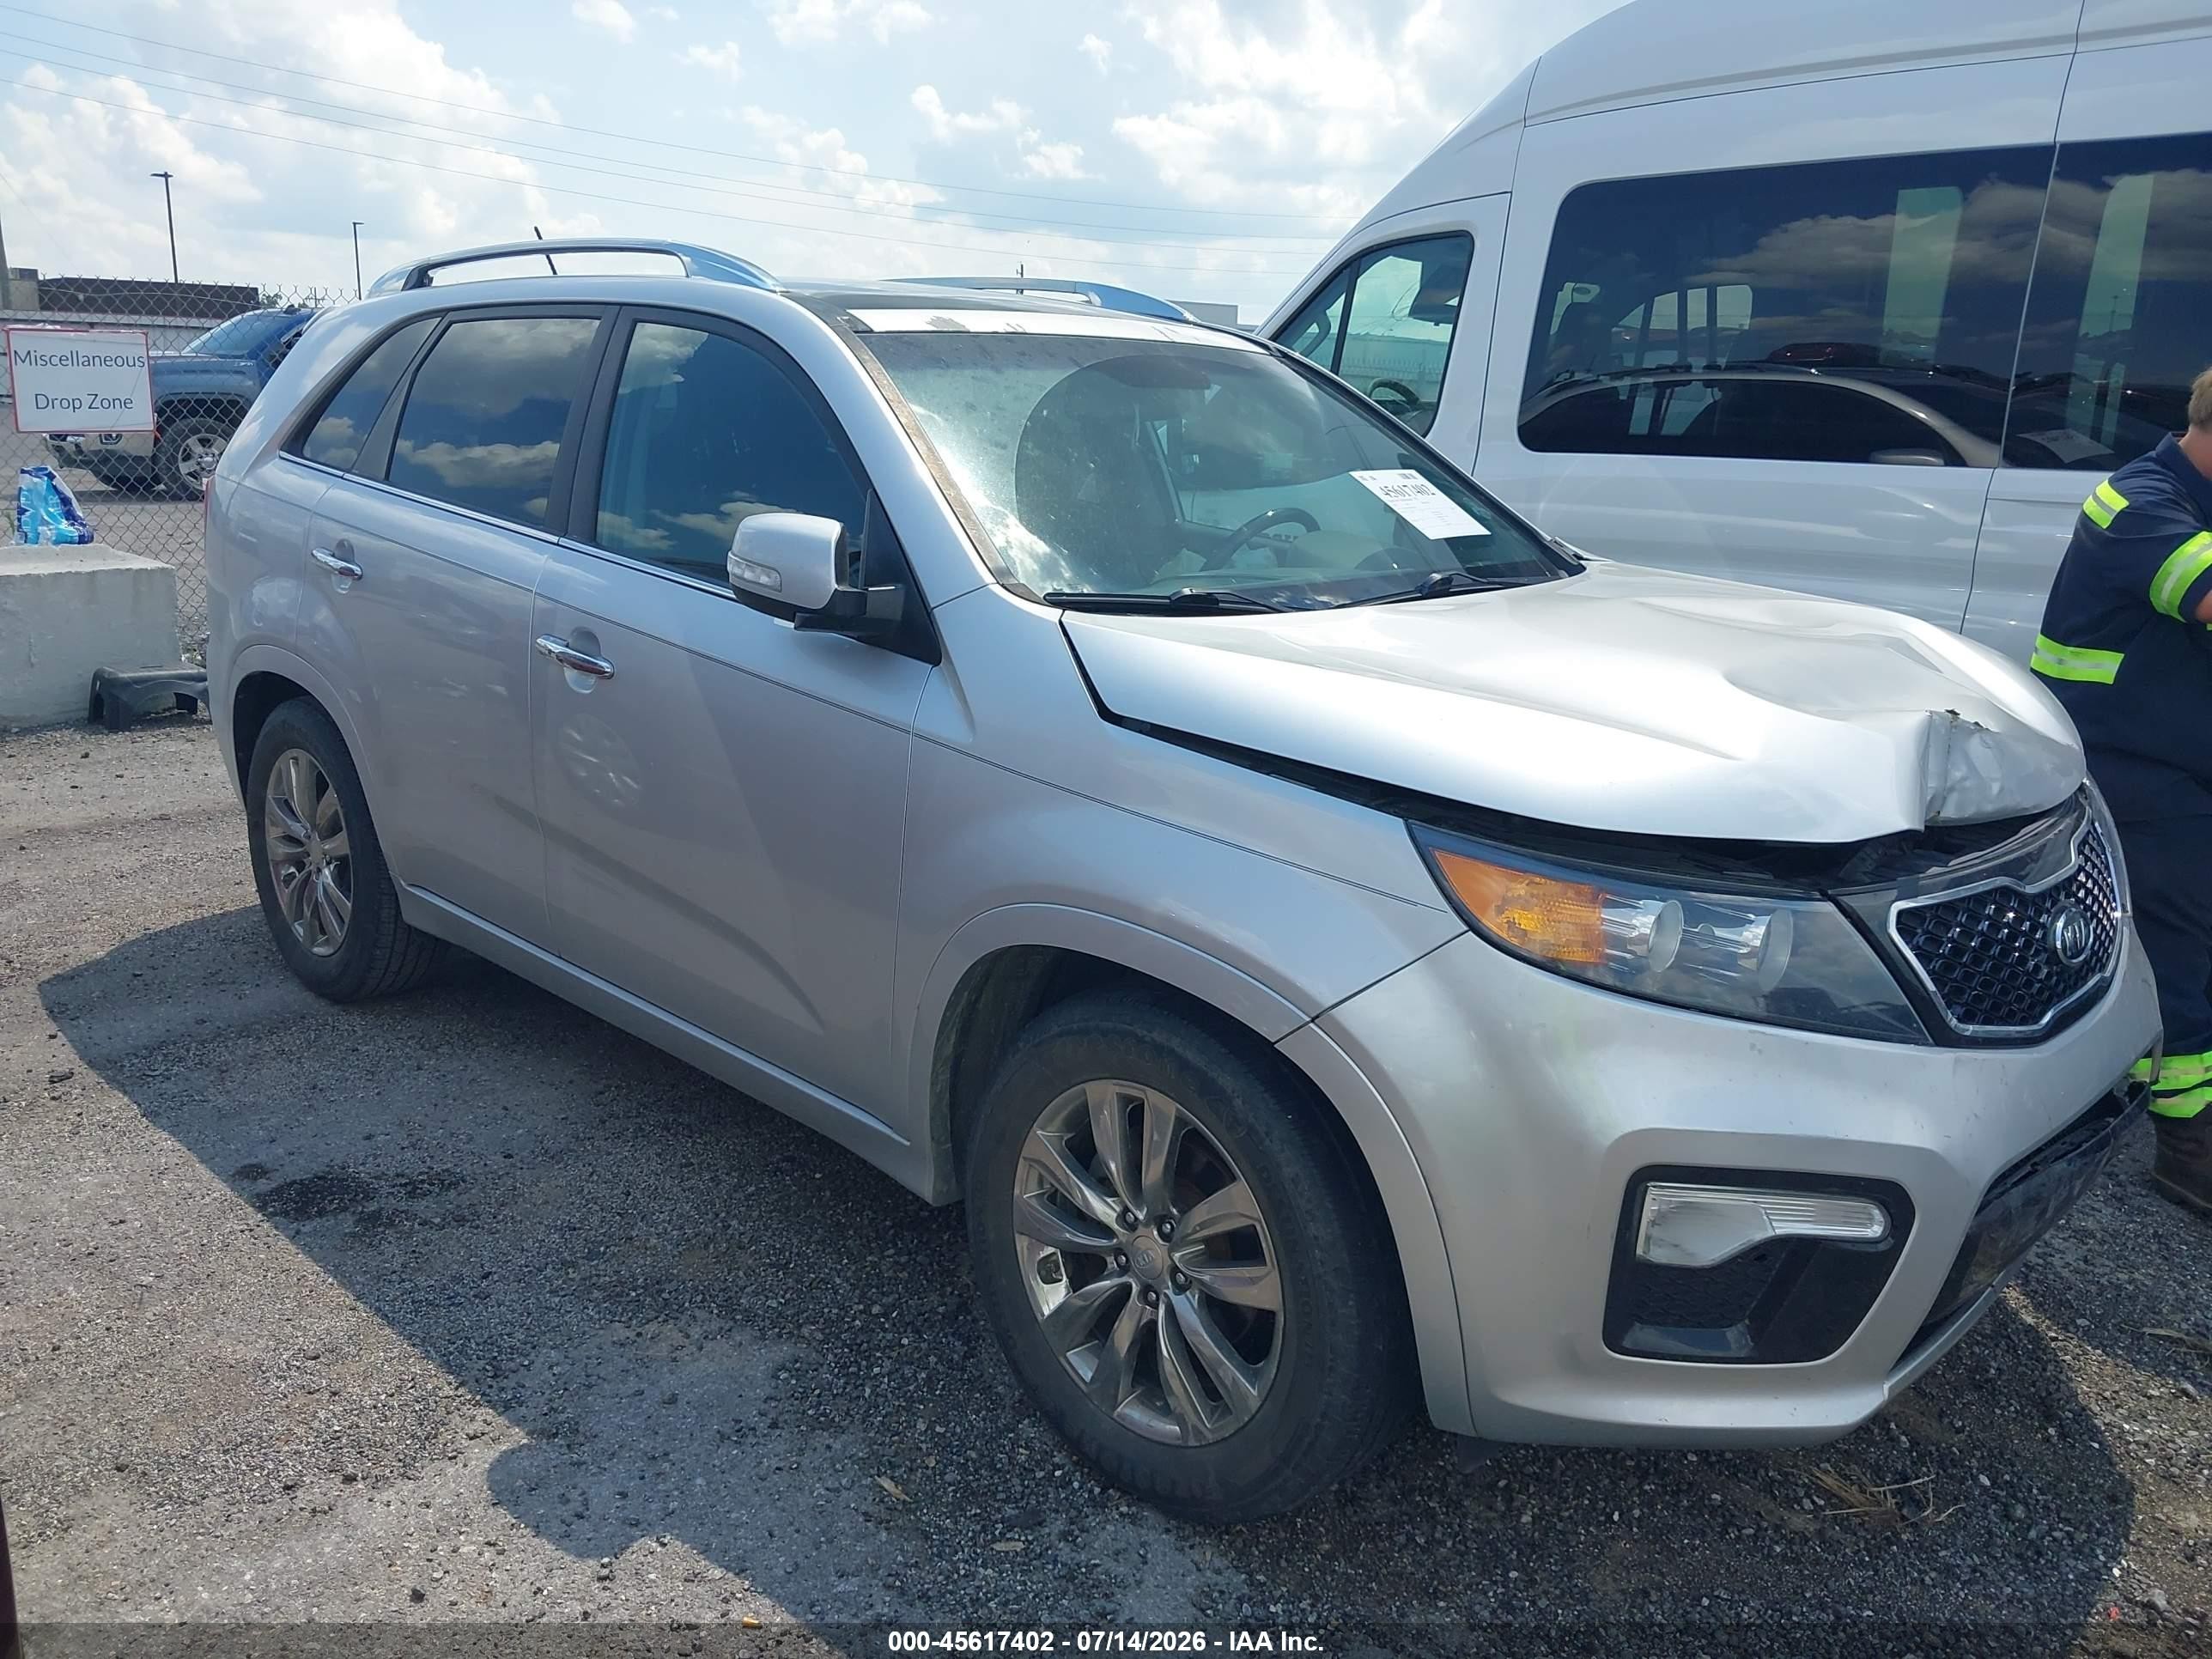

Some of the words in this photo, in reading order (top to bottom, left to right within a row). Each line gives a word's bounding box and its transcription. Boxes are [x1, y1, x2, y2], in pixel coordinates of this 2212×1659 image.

[14, 349, 145, 368] Miscellaneous
[34, 393, 82, 412] Drop
[87, 393, 134, 410] Zone
